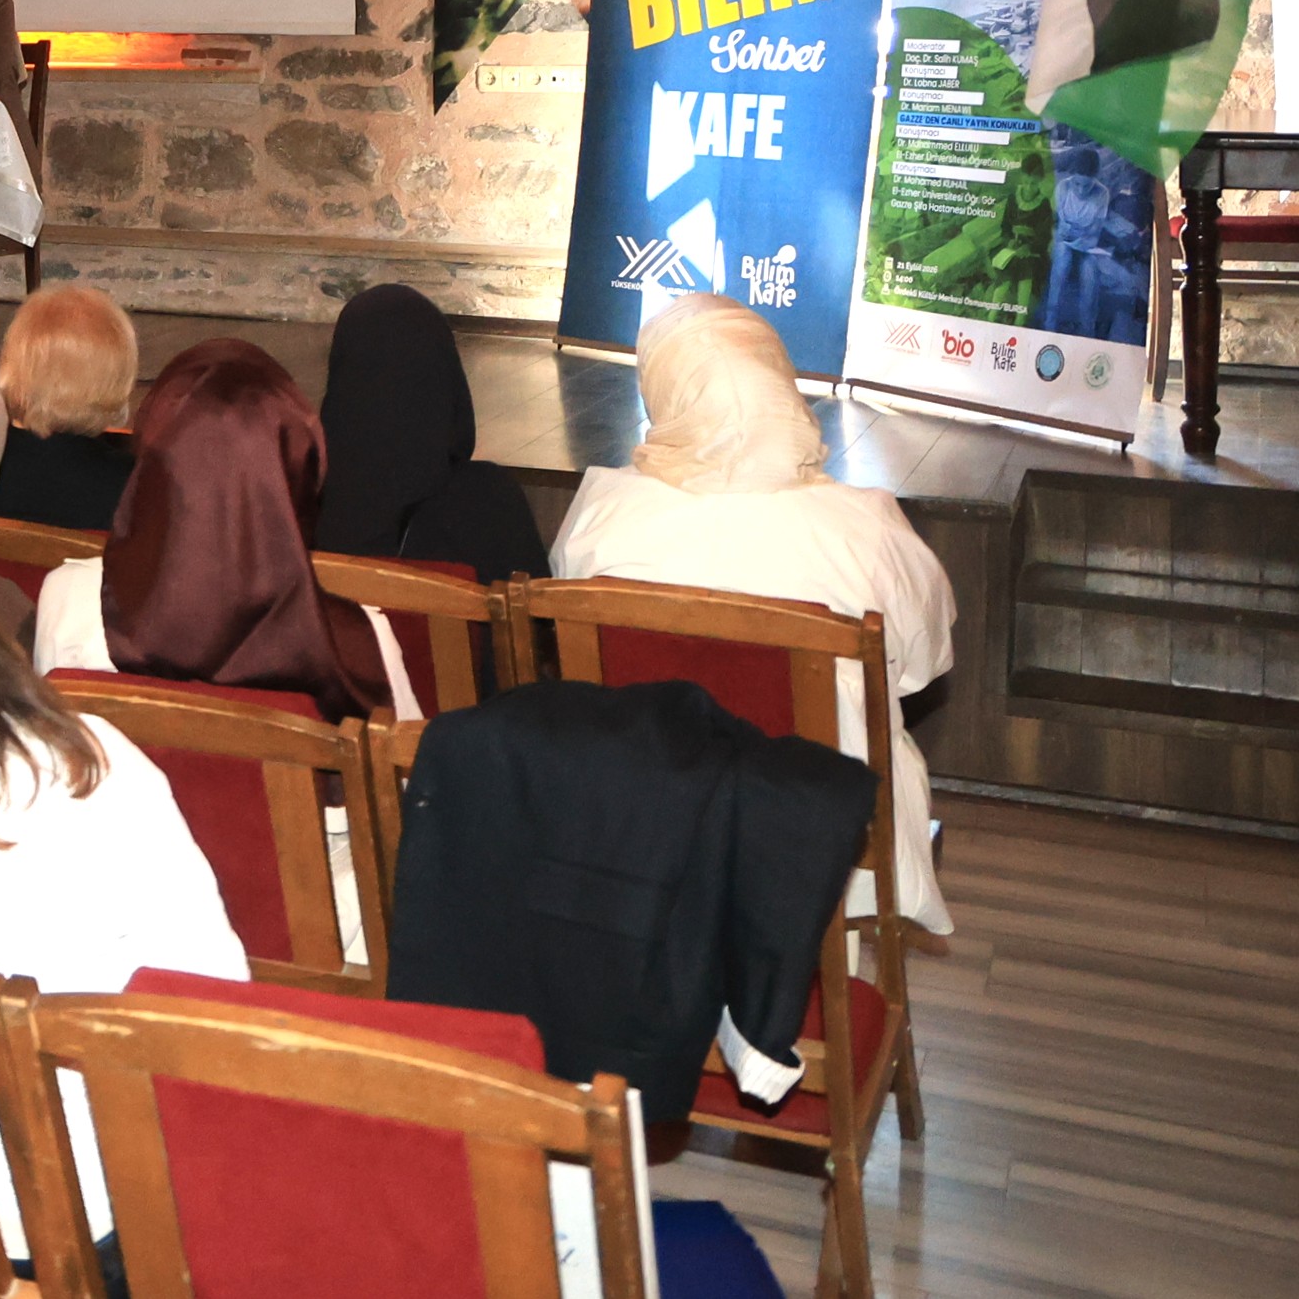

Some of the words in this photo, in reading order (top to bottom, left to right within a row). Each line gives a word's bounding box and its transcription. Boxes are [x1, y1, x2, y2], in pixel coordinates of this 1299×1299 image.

[708, 29, 825, 73] Sohbet
[923, 54, 933, 63] Dr.
[934, 54, 951, 63] Salih
[953, 55, 979, 67] KUMAŞ
[904, 67, 945, 77] Konuşmacı
[903, 79, 913, 87] Dr.
[938, 80, 960, 88] JABER
[902, 91, 943, 102] Konuşmacı
[901, 102, 910, 111] Dr.
[661, 90, 786, 160] KAFE
[941, 116, 963, 126] CANLI
[965, 118, 989, 128] YAYIN
[991, 119, 1036, 131] KONUKLARI
[899, 128, 940, 138] Konuşmacı
[897, 138, 906, 147] Dr.
[895, 164, 936, 174] Konuşmacı
[893, 175, 902, 183] Dr.
[891, 198, 912, 209] Gazze
[928, 203, 966, 215] Hastanesi
[967, 206, 996, 219] Doktoru
[749, 276, 797, 308] Kafe
[994, 355, 1016, 372] Kafe
